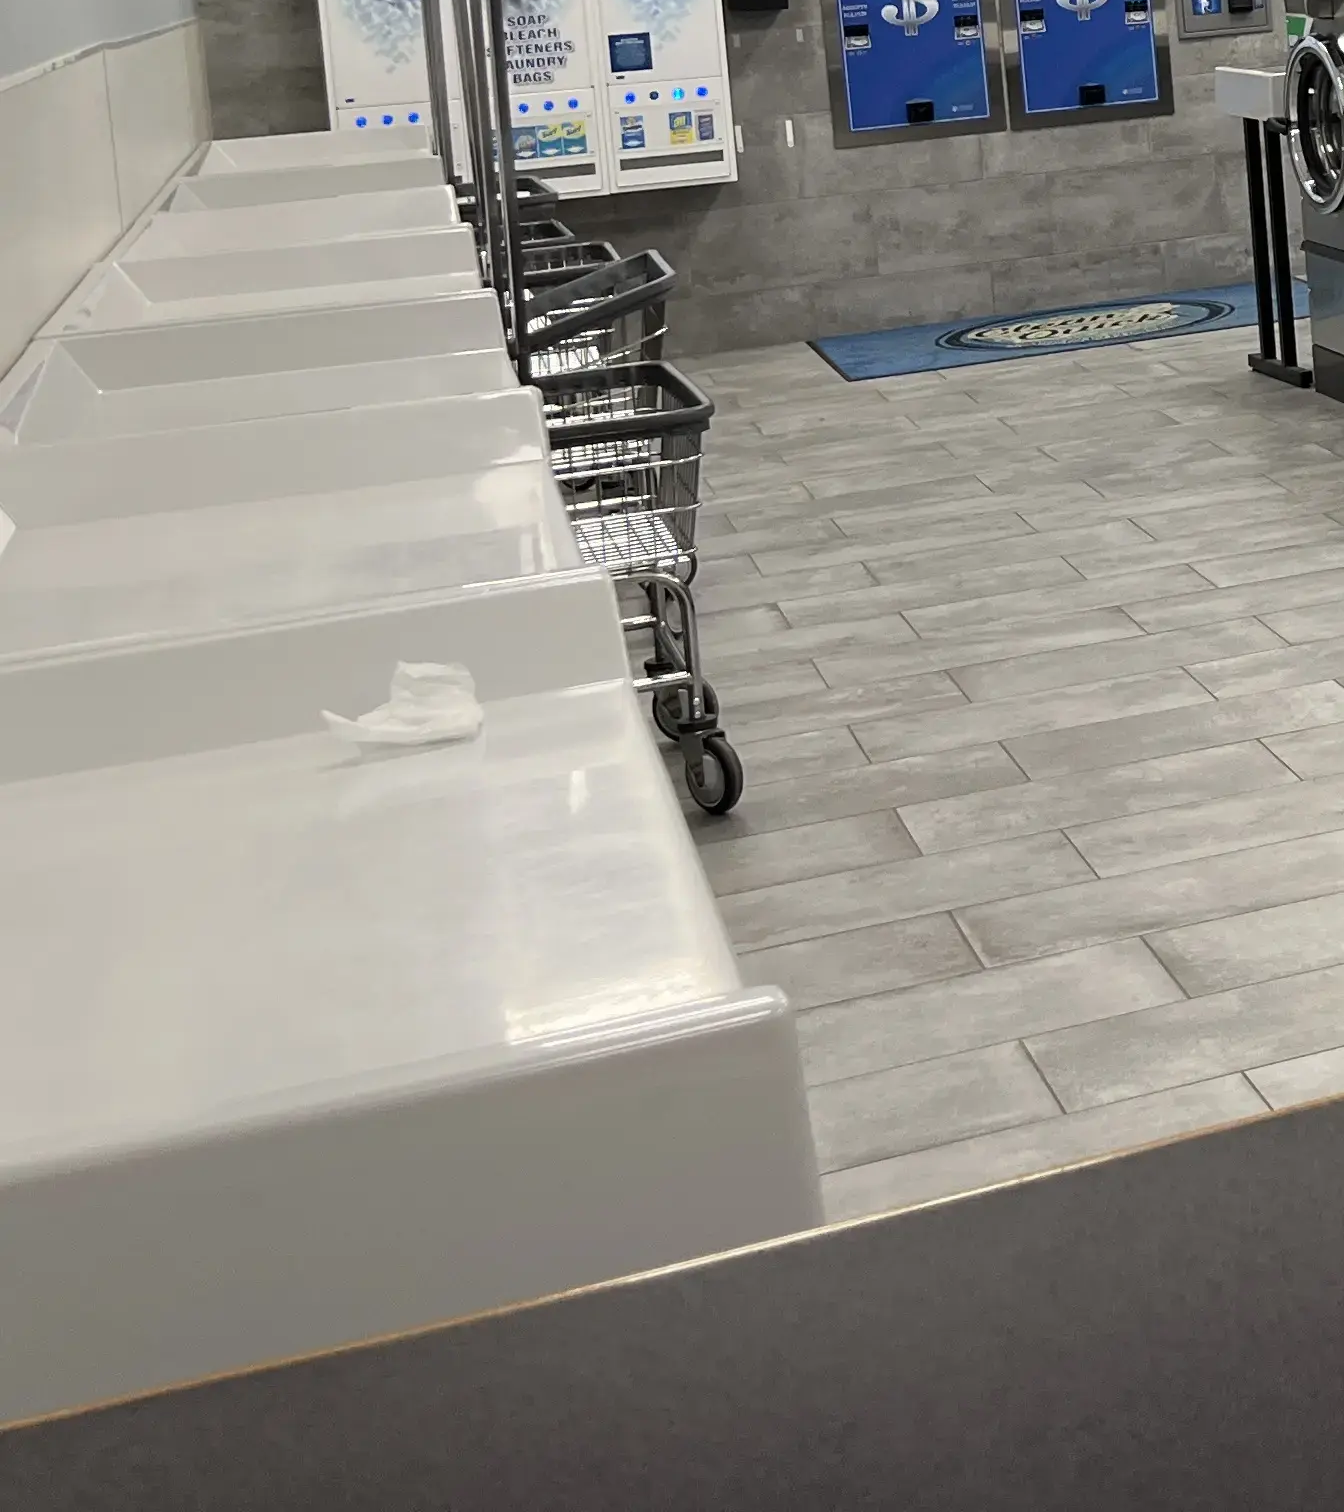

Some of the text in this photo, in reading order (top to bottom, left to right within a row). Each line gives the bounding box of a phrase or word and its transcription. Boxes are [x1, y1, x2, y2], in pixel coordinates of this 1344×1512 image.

[507, 14, 547, 27] SOAP
[506, 40, 573, 56] FTENERS
[506, 55, 565, 70] AUNDRY
[513, 71, 552, 84] BAGS
